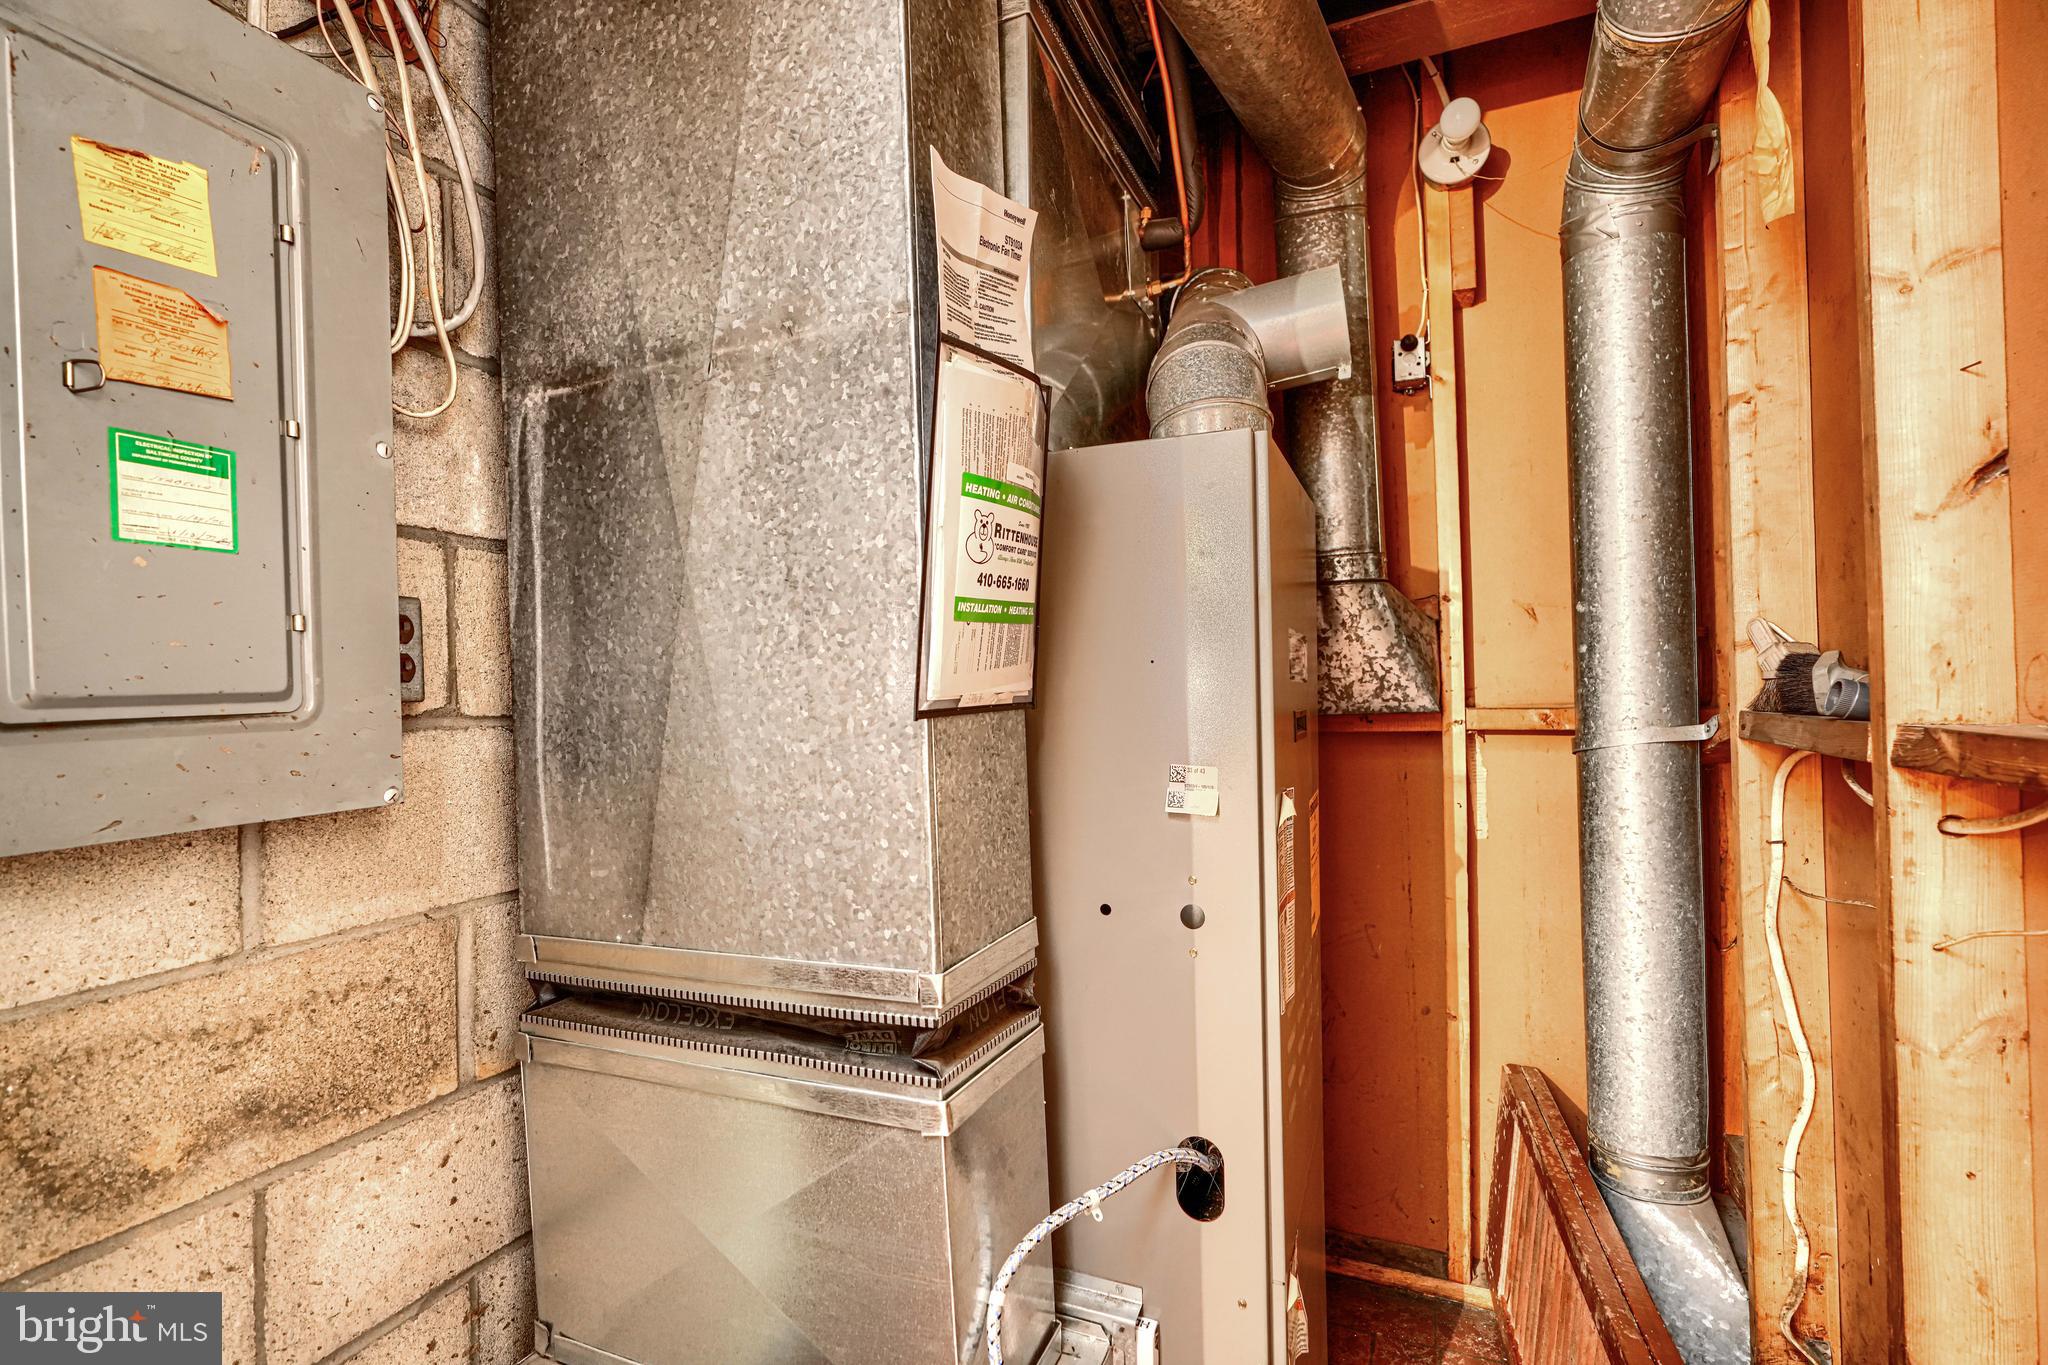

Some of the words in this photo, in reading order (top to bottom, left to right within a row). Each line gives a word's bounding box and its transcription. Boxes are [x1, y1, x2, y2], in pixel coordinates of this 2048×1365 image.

[1003, 208, 1027, 226] Honeywell
[979, 235, 1001, 254] Electronic
[1001, 244, 1010, 257] Fan
[1011, 248, 1022, 262] Timer
[979, 303, 995, 313] CAUTION
[135, 440, 172, 452] ELECTRICAL
[172, 448, 205, 459] INSPECTION
[145, 449, 180, 460] BALTIMORE
[180, 455, 204, 464] COUNTY
[965, 482, 1001, 500] HEATING
[1006, 493, 1018, 506] AIR
[994, 522, 1039, 548] RITTENHOUSE
[957, 601, 1003, 615] INSTALLATION
[1008, 605, 1029, 616] HEATING
[637, 999, 735, 1030] EXCELON
